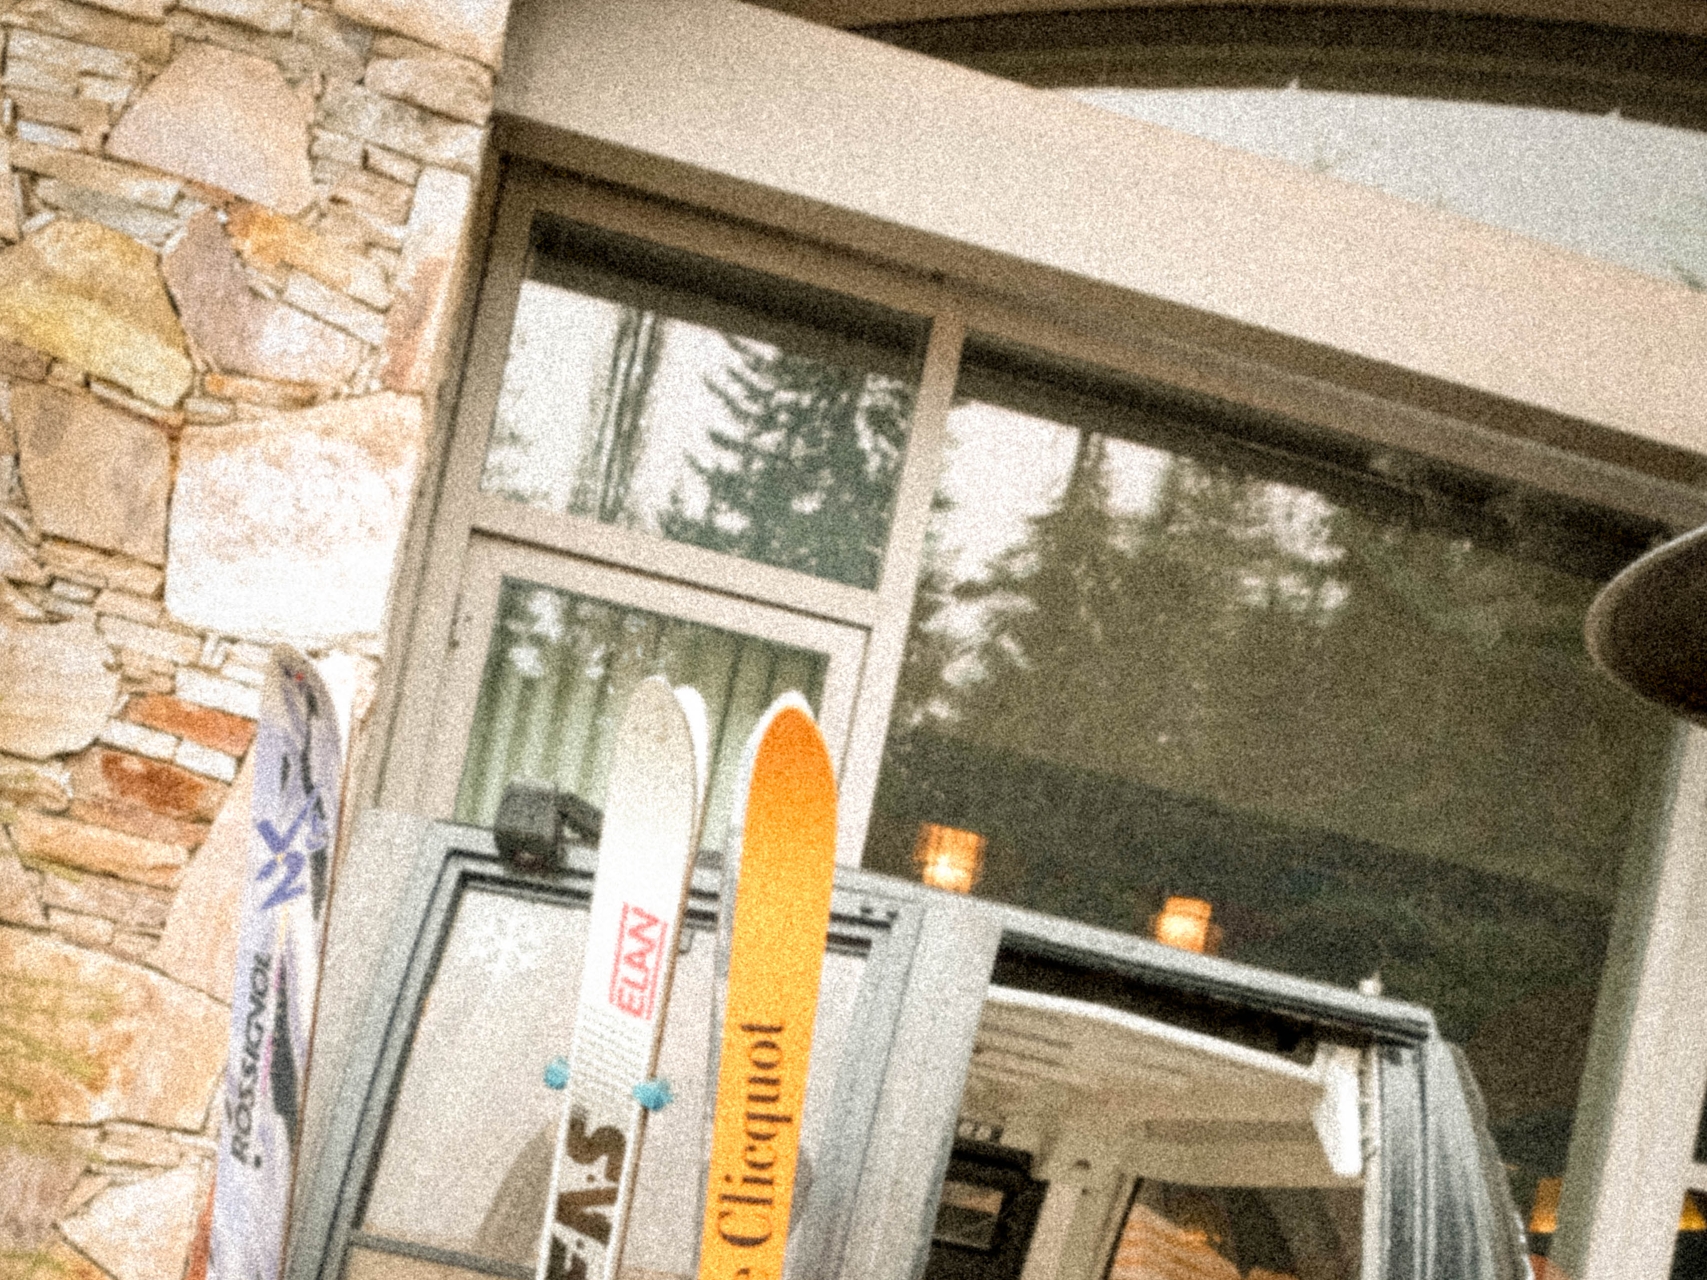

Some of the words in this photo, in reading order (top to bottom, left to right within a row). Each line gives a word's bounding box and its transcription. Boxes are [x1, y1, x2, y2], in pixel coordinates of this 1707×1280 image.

[231, 952, 272, 1164] ROSSIGNOL
[615, 906, 660, 1019] ELAN
[717, 1023, 793, 1248] Clicquot
